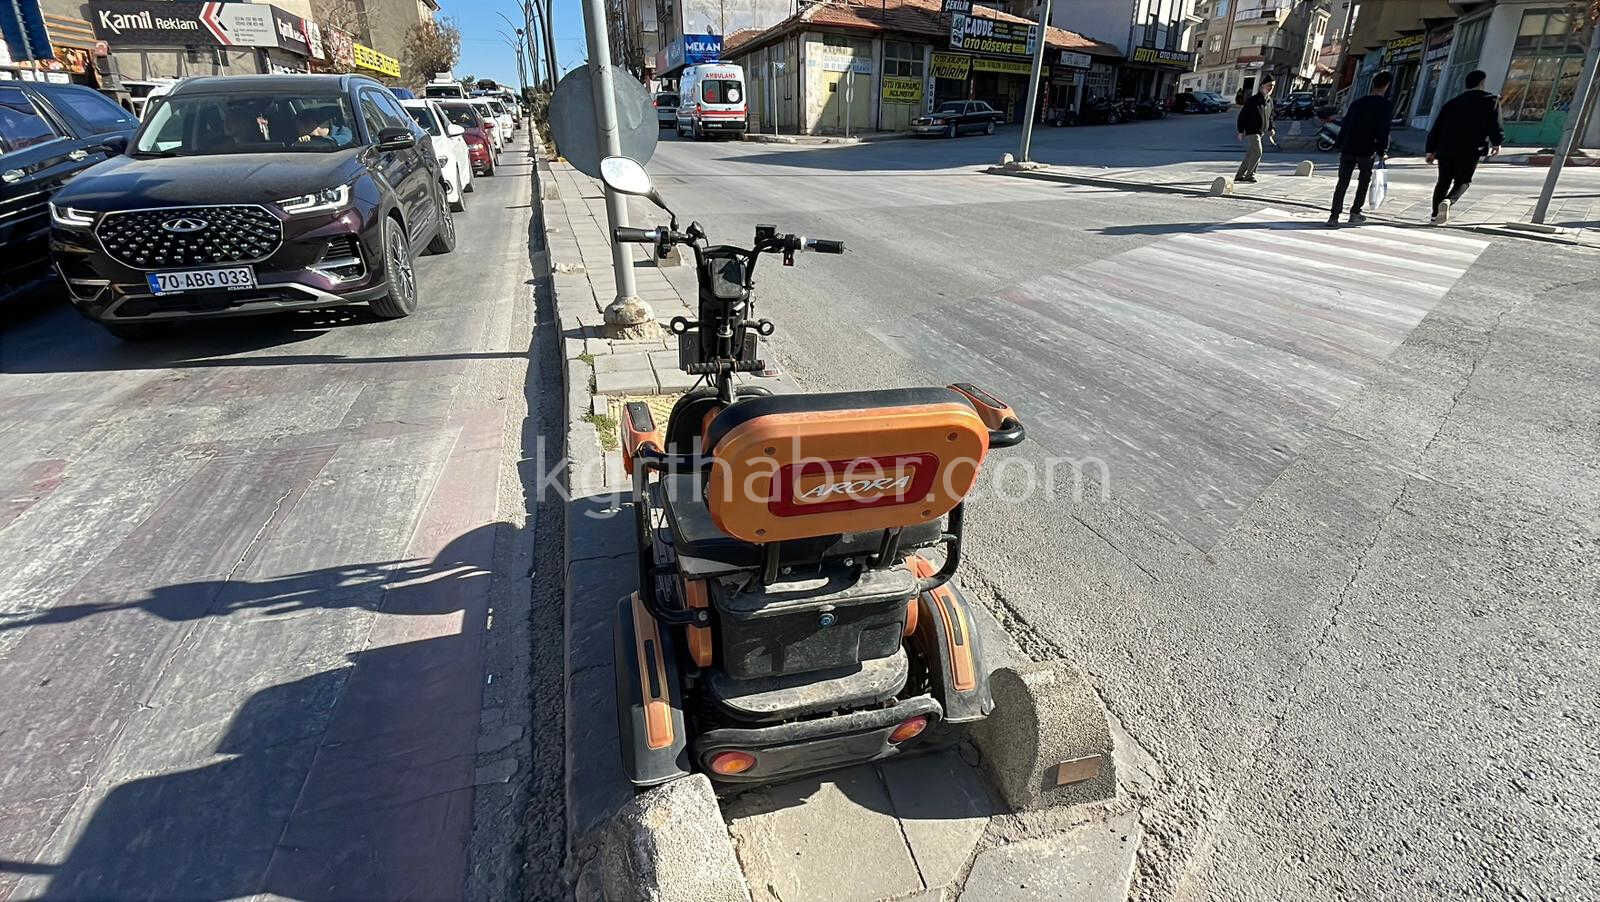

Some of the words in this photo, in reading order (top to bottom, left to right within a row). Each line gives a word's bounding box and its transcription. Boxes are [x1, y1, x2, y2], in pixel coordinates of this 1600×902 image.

[98, 10, 153, 34] Kamil
[156, 18, 199, 30] Reklam
[685, 42, 721, 52] MEKAN
[964, 37, 980, 50] OTO
[980, 39, 1012, 53] DÖŞEME
[158, 275, 180, 289] 70
[185, 272, 216, 288] ABG
[218, 270, 249, 285] 033
[801, 475, 910, 498] ARORA
